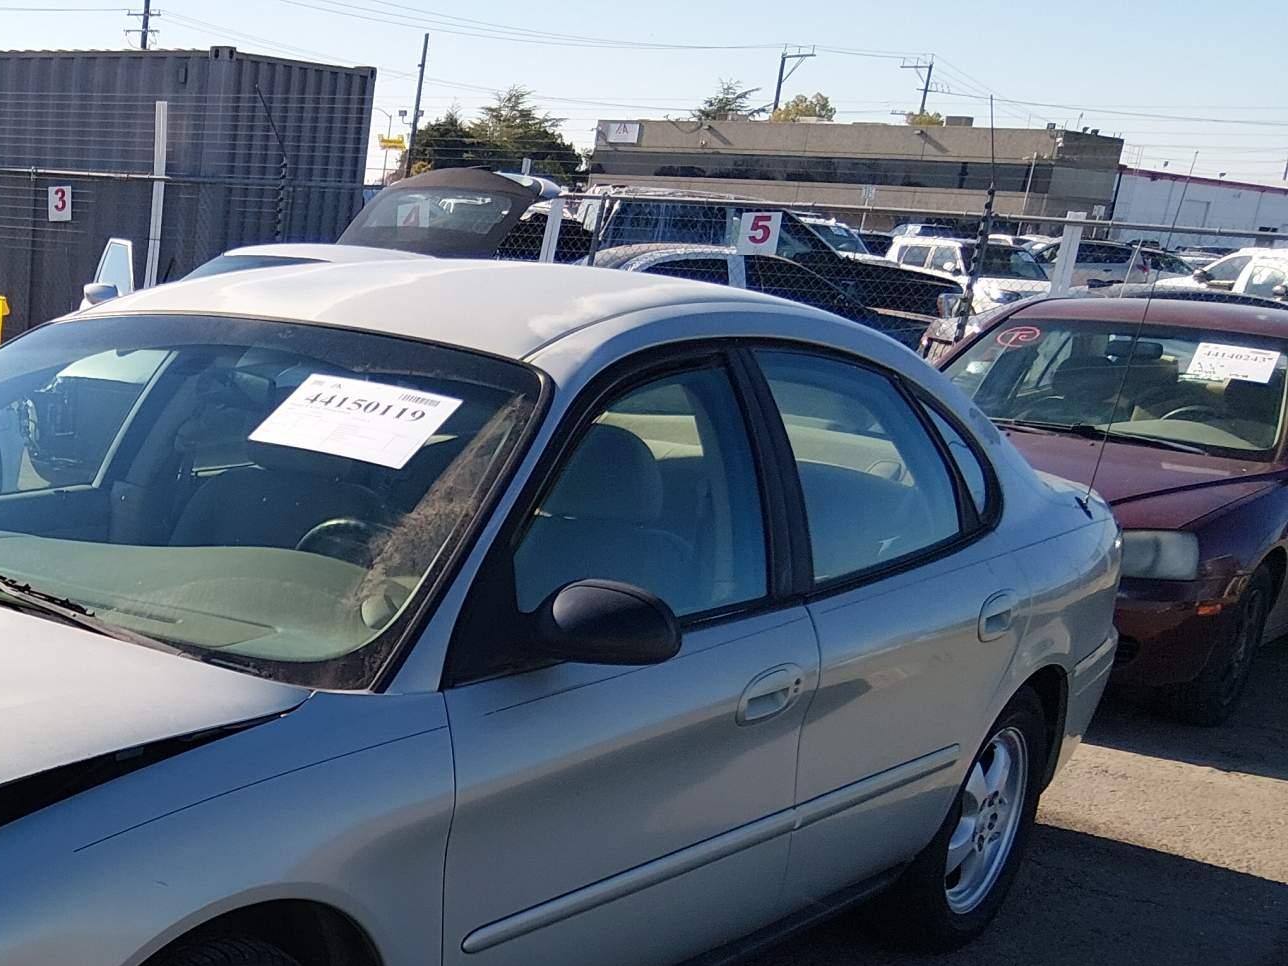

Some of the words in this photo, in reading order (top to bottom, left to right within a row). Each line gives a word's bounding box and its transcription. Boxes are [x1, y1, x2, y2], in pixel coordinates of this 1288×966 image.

[54, 188, 67, 212] 3
[748, 215, 772, 245] 5
[305, 391, 427, 423] 44150119
